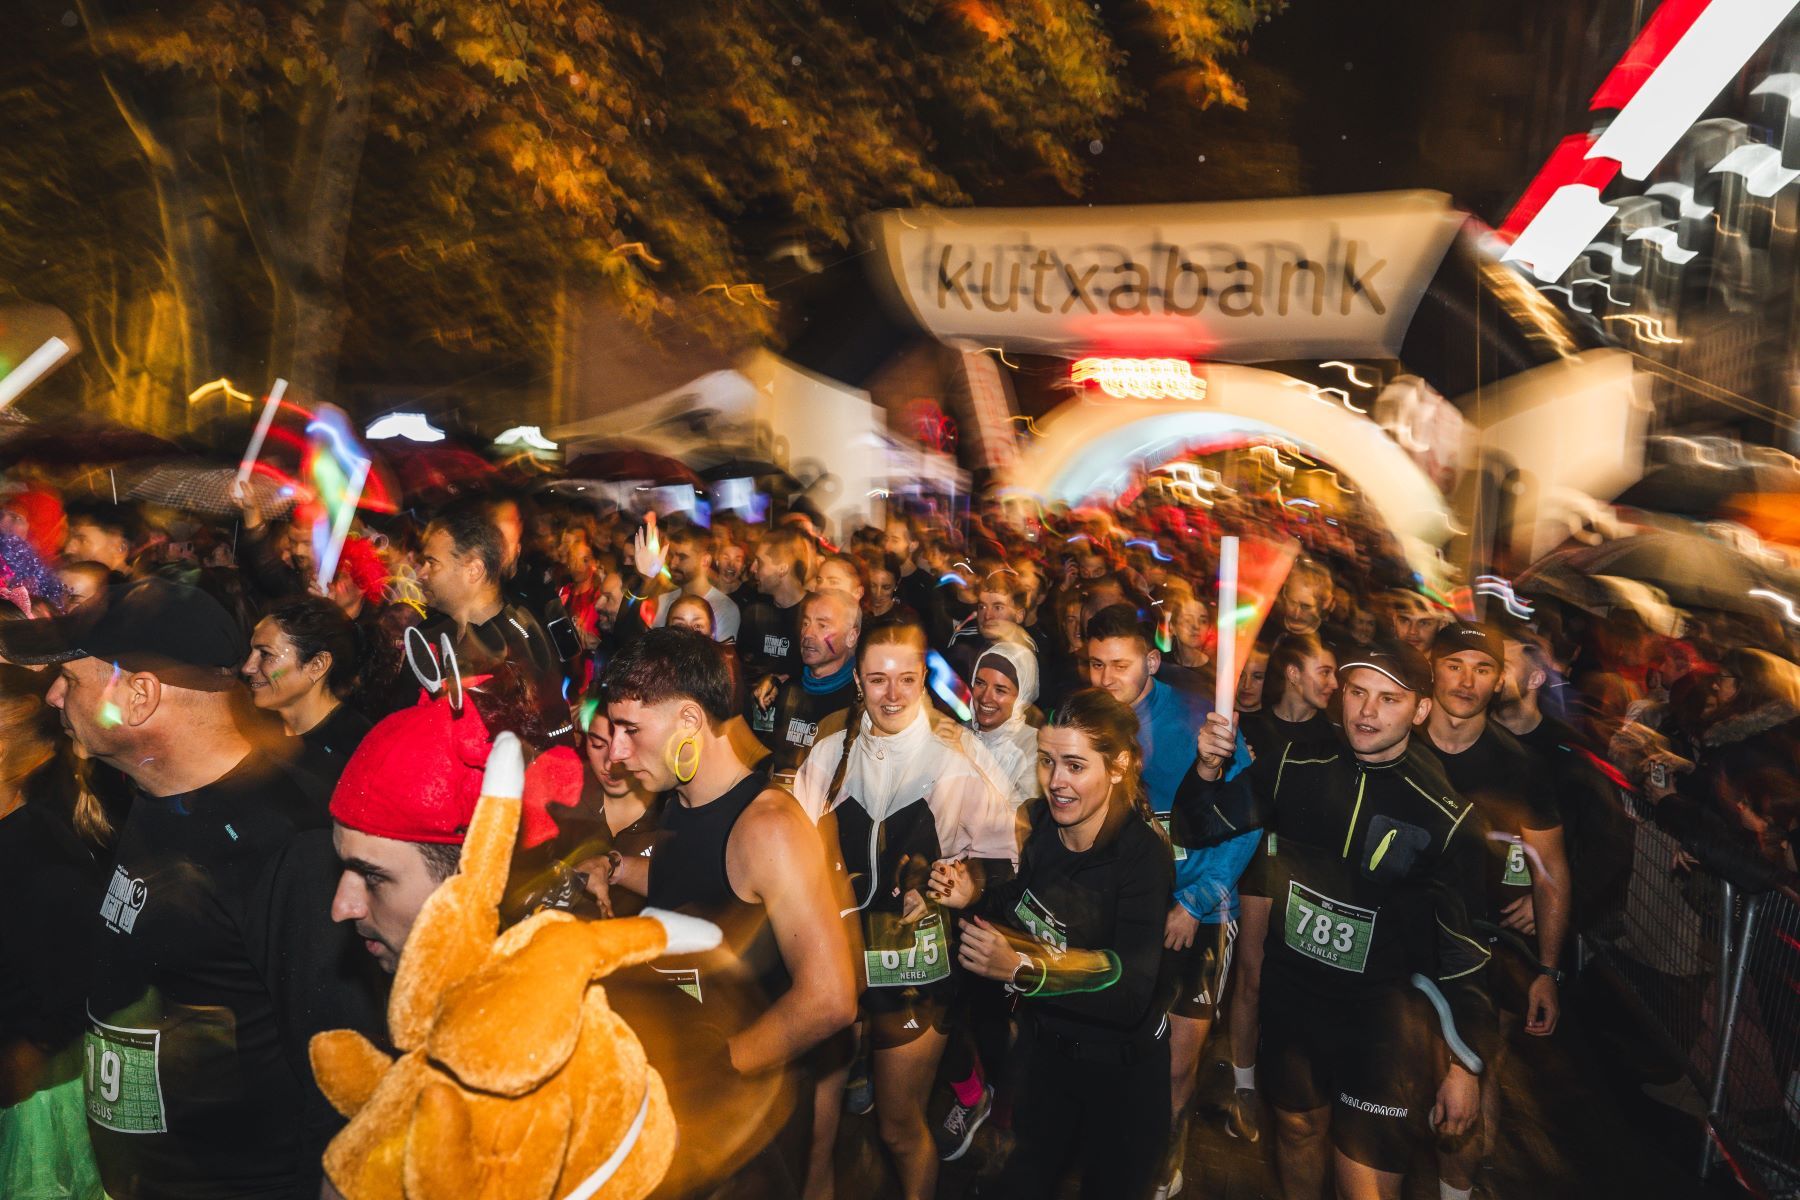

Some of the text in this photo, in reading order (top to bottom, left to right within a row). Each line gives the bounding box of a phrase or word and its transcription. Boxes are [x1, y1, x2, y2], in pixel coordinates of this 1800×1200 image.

[936, 239, 1388, 317] kutxabank
[1296, 904, 1355, 953] 783
[899, 970, 927, 980] NEREA
[1340, 1092, 1408, 1118] SALOMON
